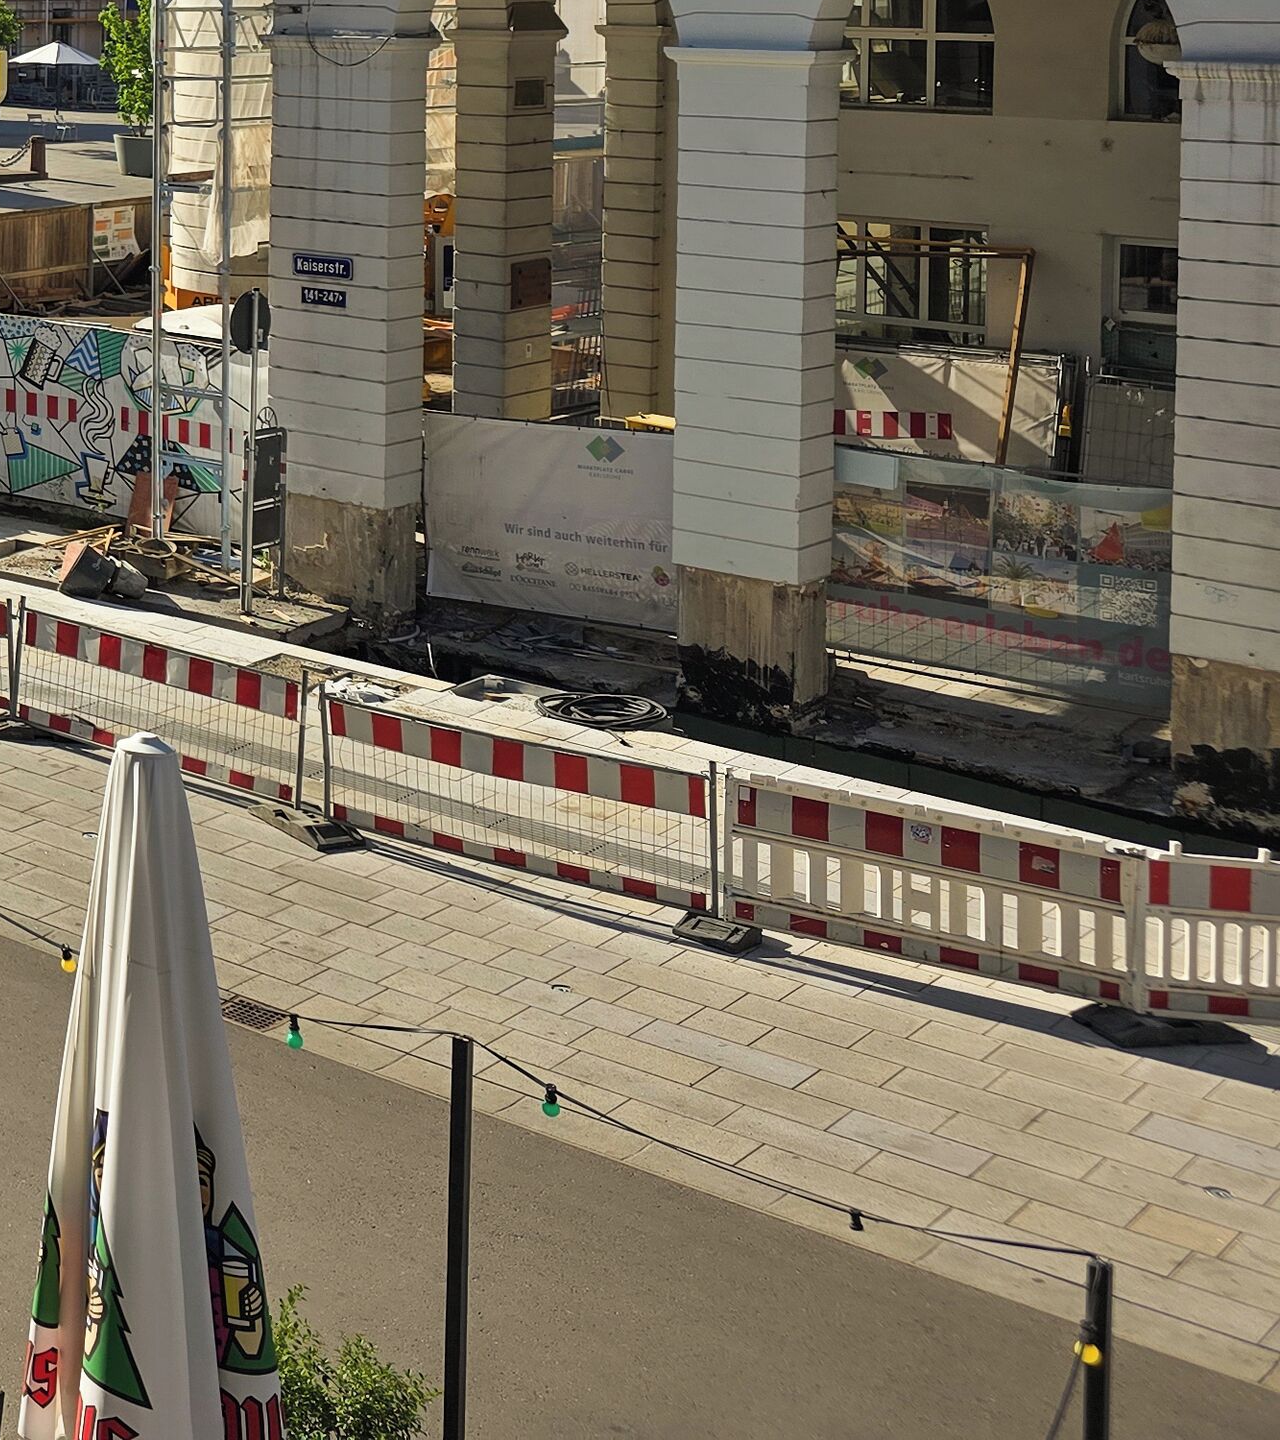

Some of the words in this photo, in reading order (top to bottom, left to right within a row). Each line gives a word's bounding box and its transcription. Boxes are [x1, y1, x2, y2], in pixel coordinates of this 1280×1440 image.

[297, 258, 347, 275] Kaiserstr.
[504, 523, 523, 536] Wir
[527, 526, 551, 539] sind
[554, 530, 582, 543] auch
[585, 535, 645, 551] weiterhin
[648, 540, 668, 553] für
[826, 594, 1171, 672] ruhe-erleben.de
